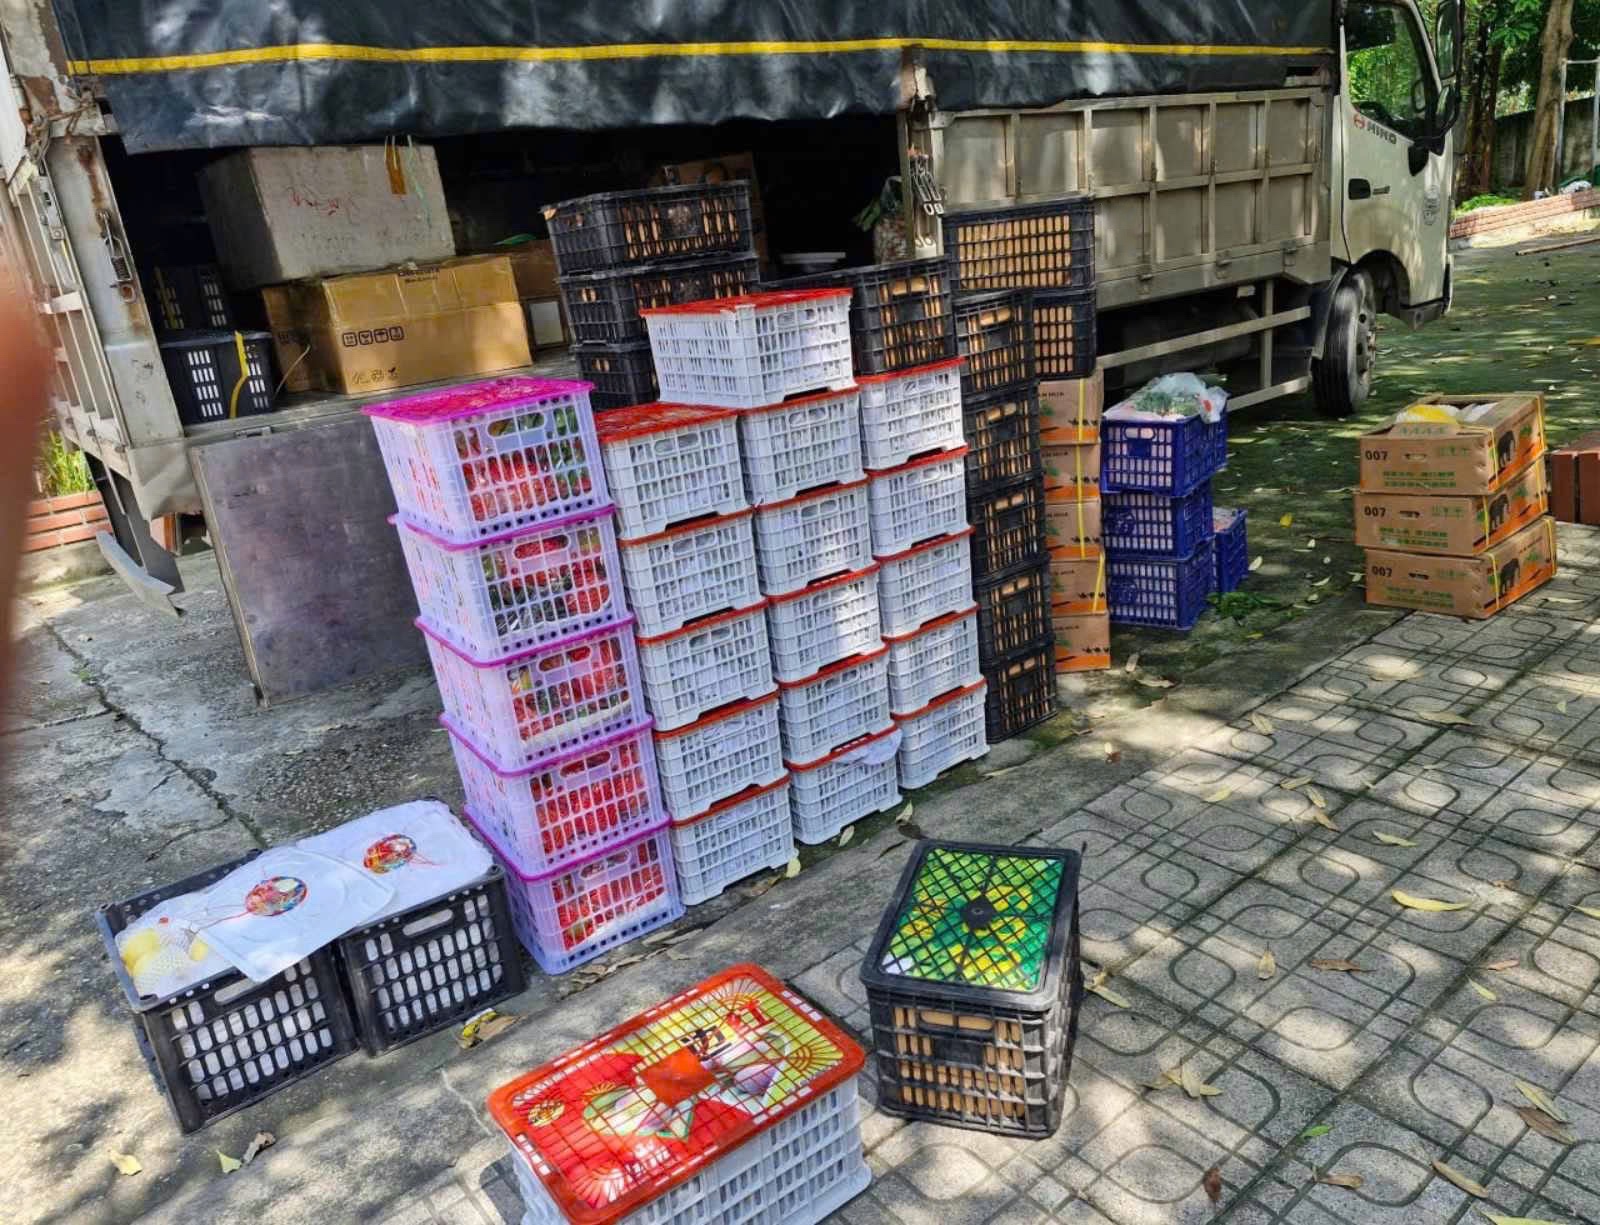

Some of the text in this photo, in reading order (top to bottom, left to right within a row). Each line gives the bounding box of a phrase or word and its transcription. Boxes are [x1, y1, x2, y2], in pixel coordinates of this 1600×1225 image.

[1367, 120, 1397, 144] HINO
[1365, 450, 1388, 460] 007
[1364, 506, 1386, 517] 007
[1372, 566, 1392, 577] 007
